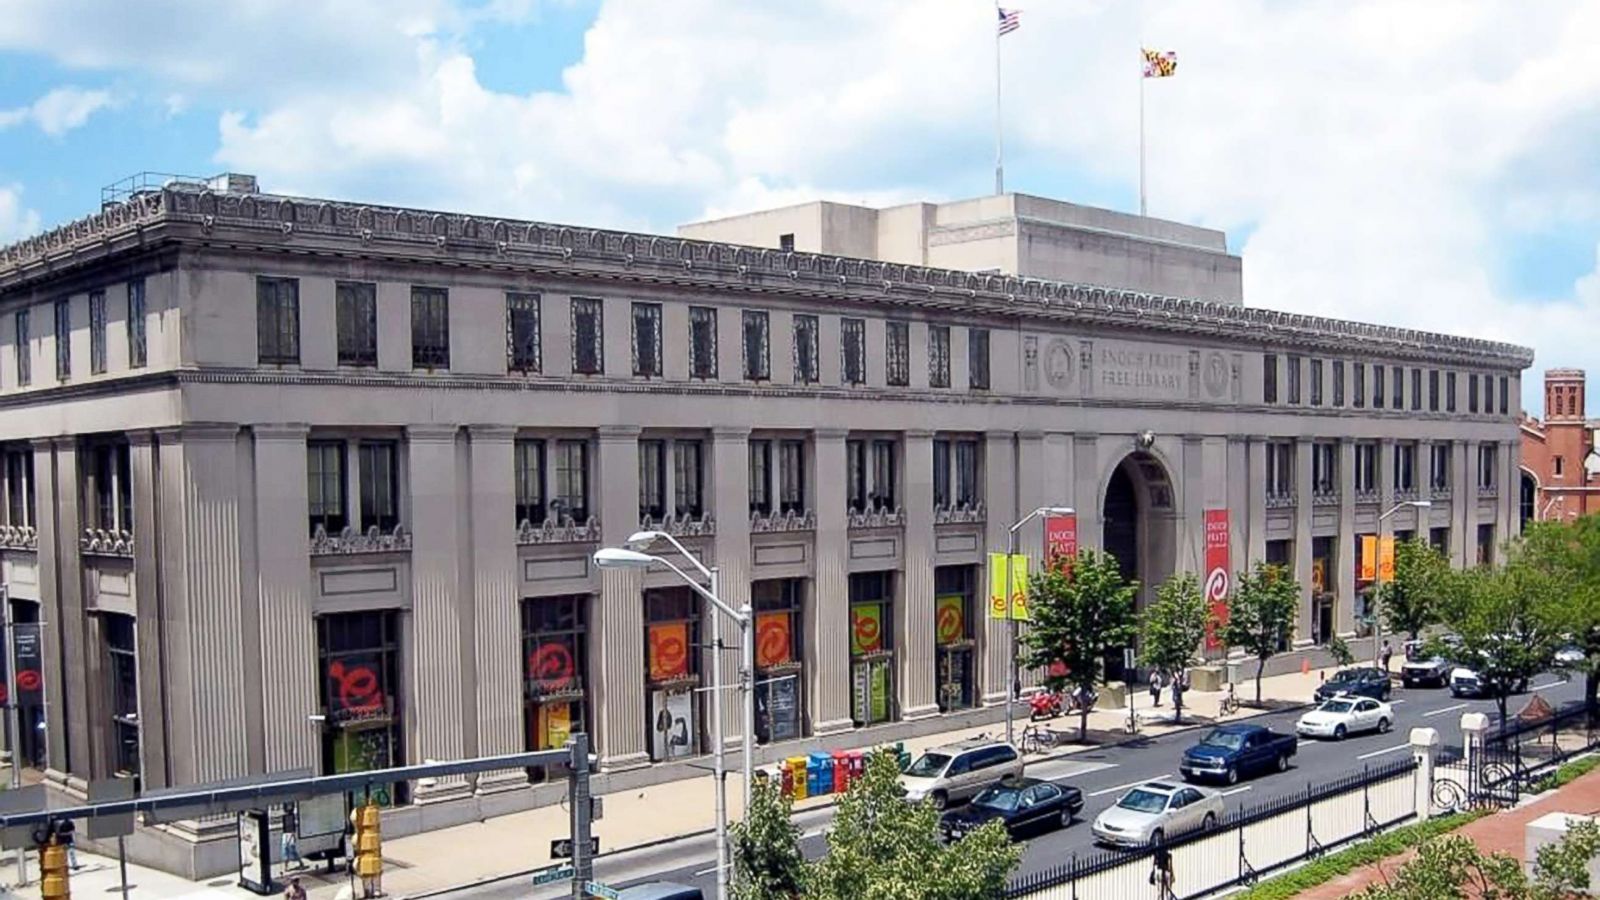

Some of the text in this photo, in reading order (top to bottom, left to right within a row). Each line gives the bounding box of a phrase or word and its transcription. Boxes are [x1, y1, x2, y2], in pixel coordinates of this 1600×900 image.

[1102, 349, 1183, 370] ENOCH PRATT
[1102, 370, 1182, 390] FREE LIBRARY
[1208, 532, 1227, 542] PRATT
